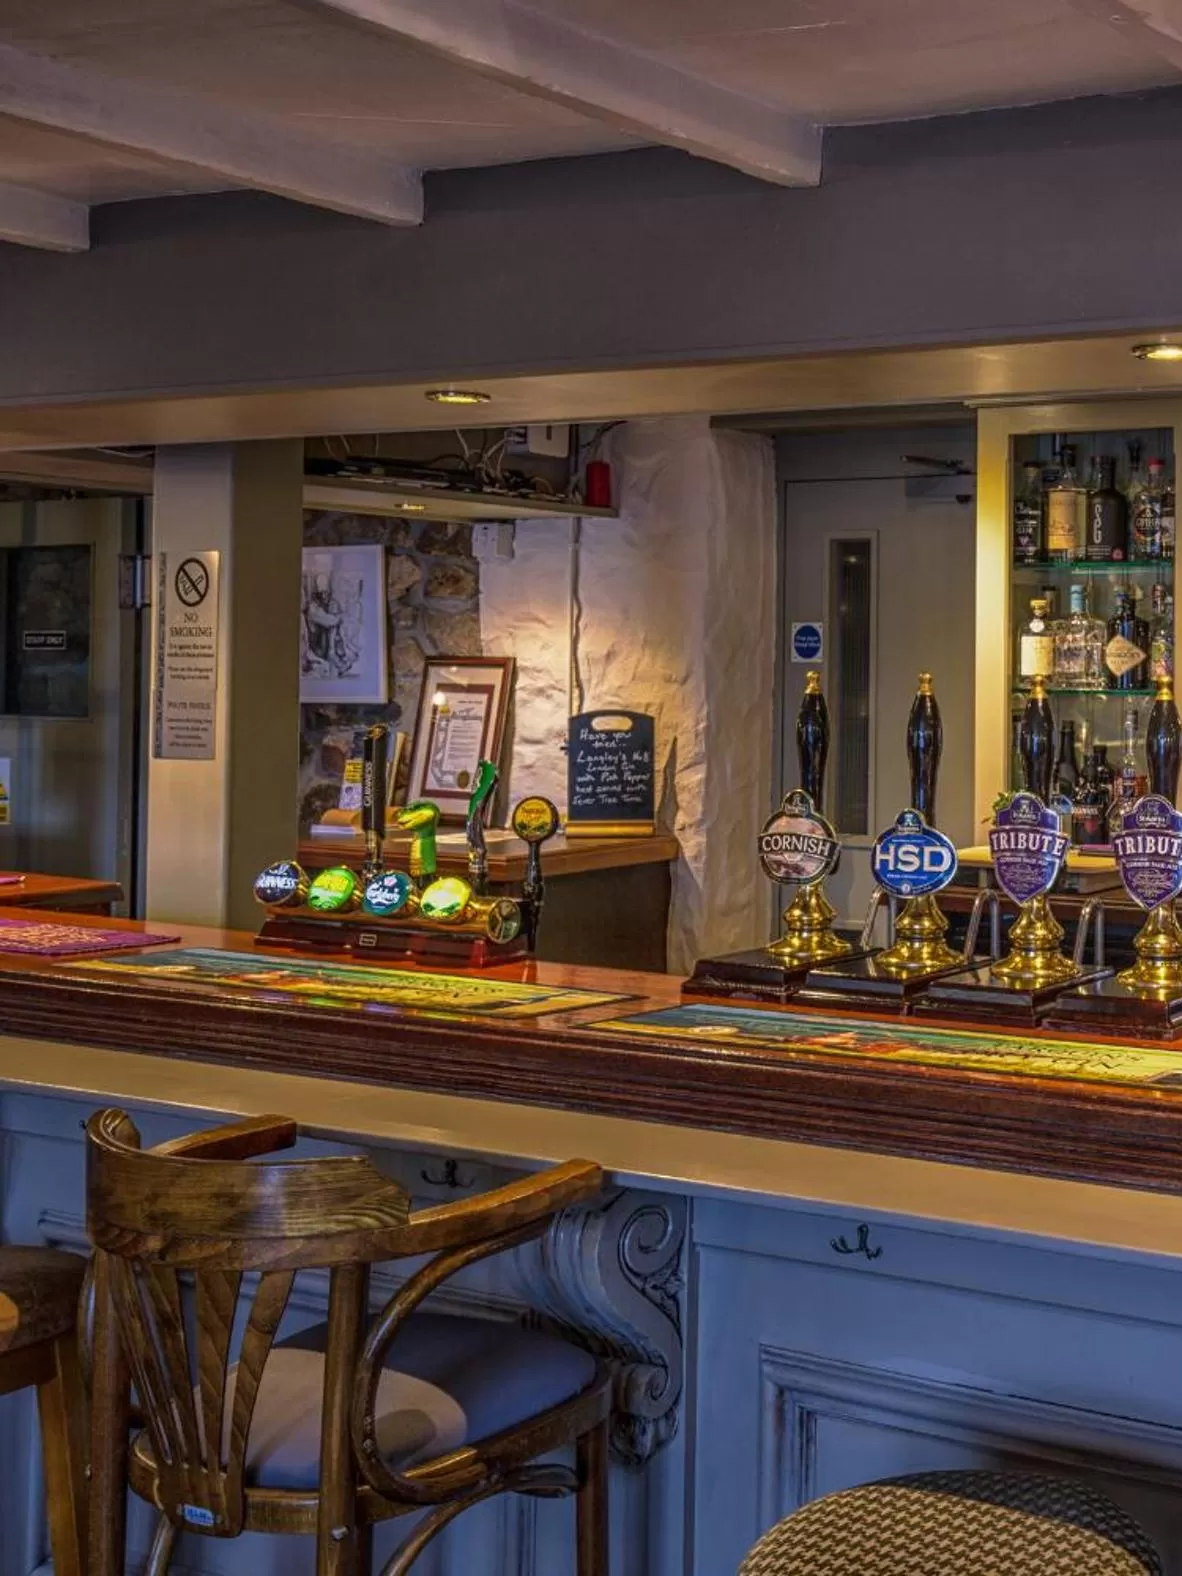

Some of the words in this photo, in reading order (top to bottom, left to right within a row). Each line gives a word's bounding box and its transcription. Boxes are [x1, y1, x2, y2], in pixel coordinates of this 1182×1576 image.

[169, 626, 212, 637] SMOKING
[580, 728, 608, 740] Have
[612, 732, 632, 742] you
[762, 836, 831, 856] CORNISH
[991, 832, 1066, 856] TRIBUTE
[875, 844, 952, 872] HSD
